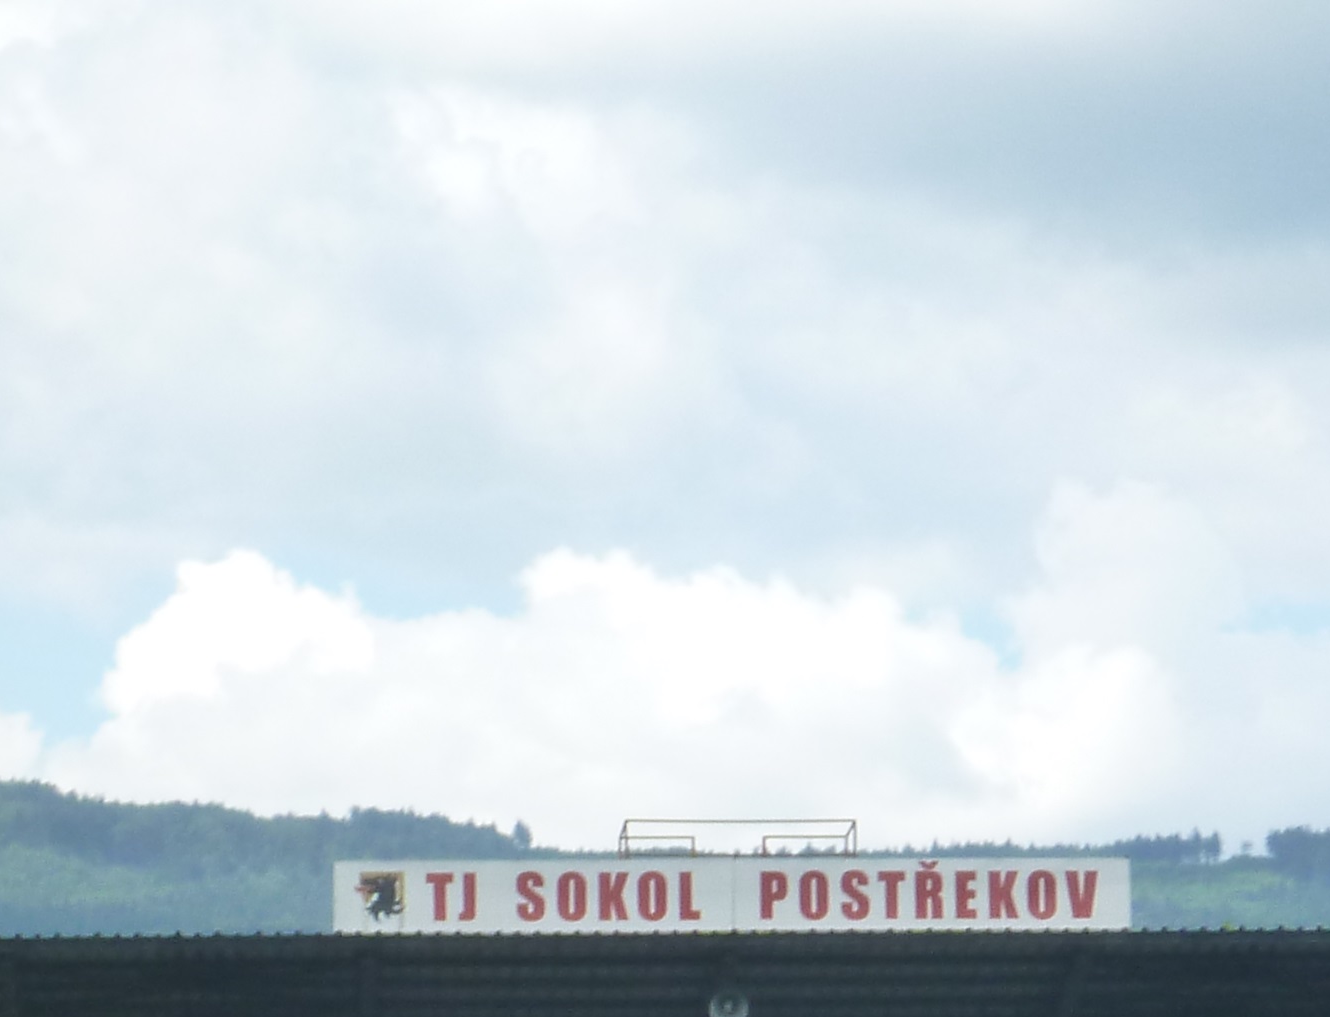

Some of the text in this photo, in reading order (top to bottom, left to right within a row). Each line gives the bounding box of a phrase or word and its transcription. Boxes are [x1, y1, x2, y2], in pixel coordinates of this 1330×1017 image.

[426, 861, 1098, 921] TJ SOKOL POSTŘEKOV
